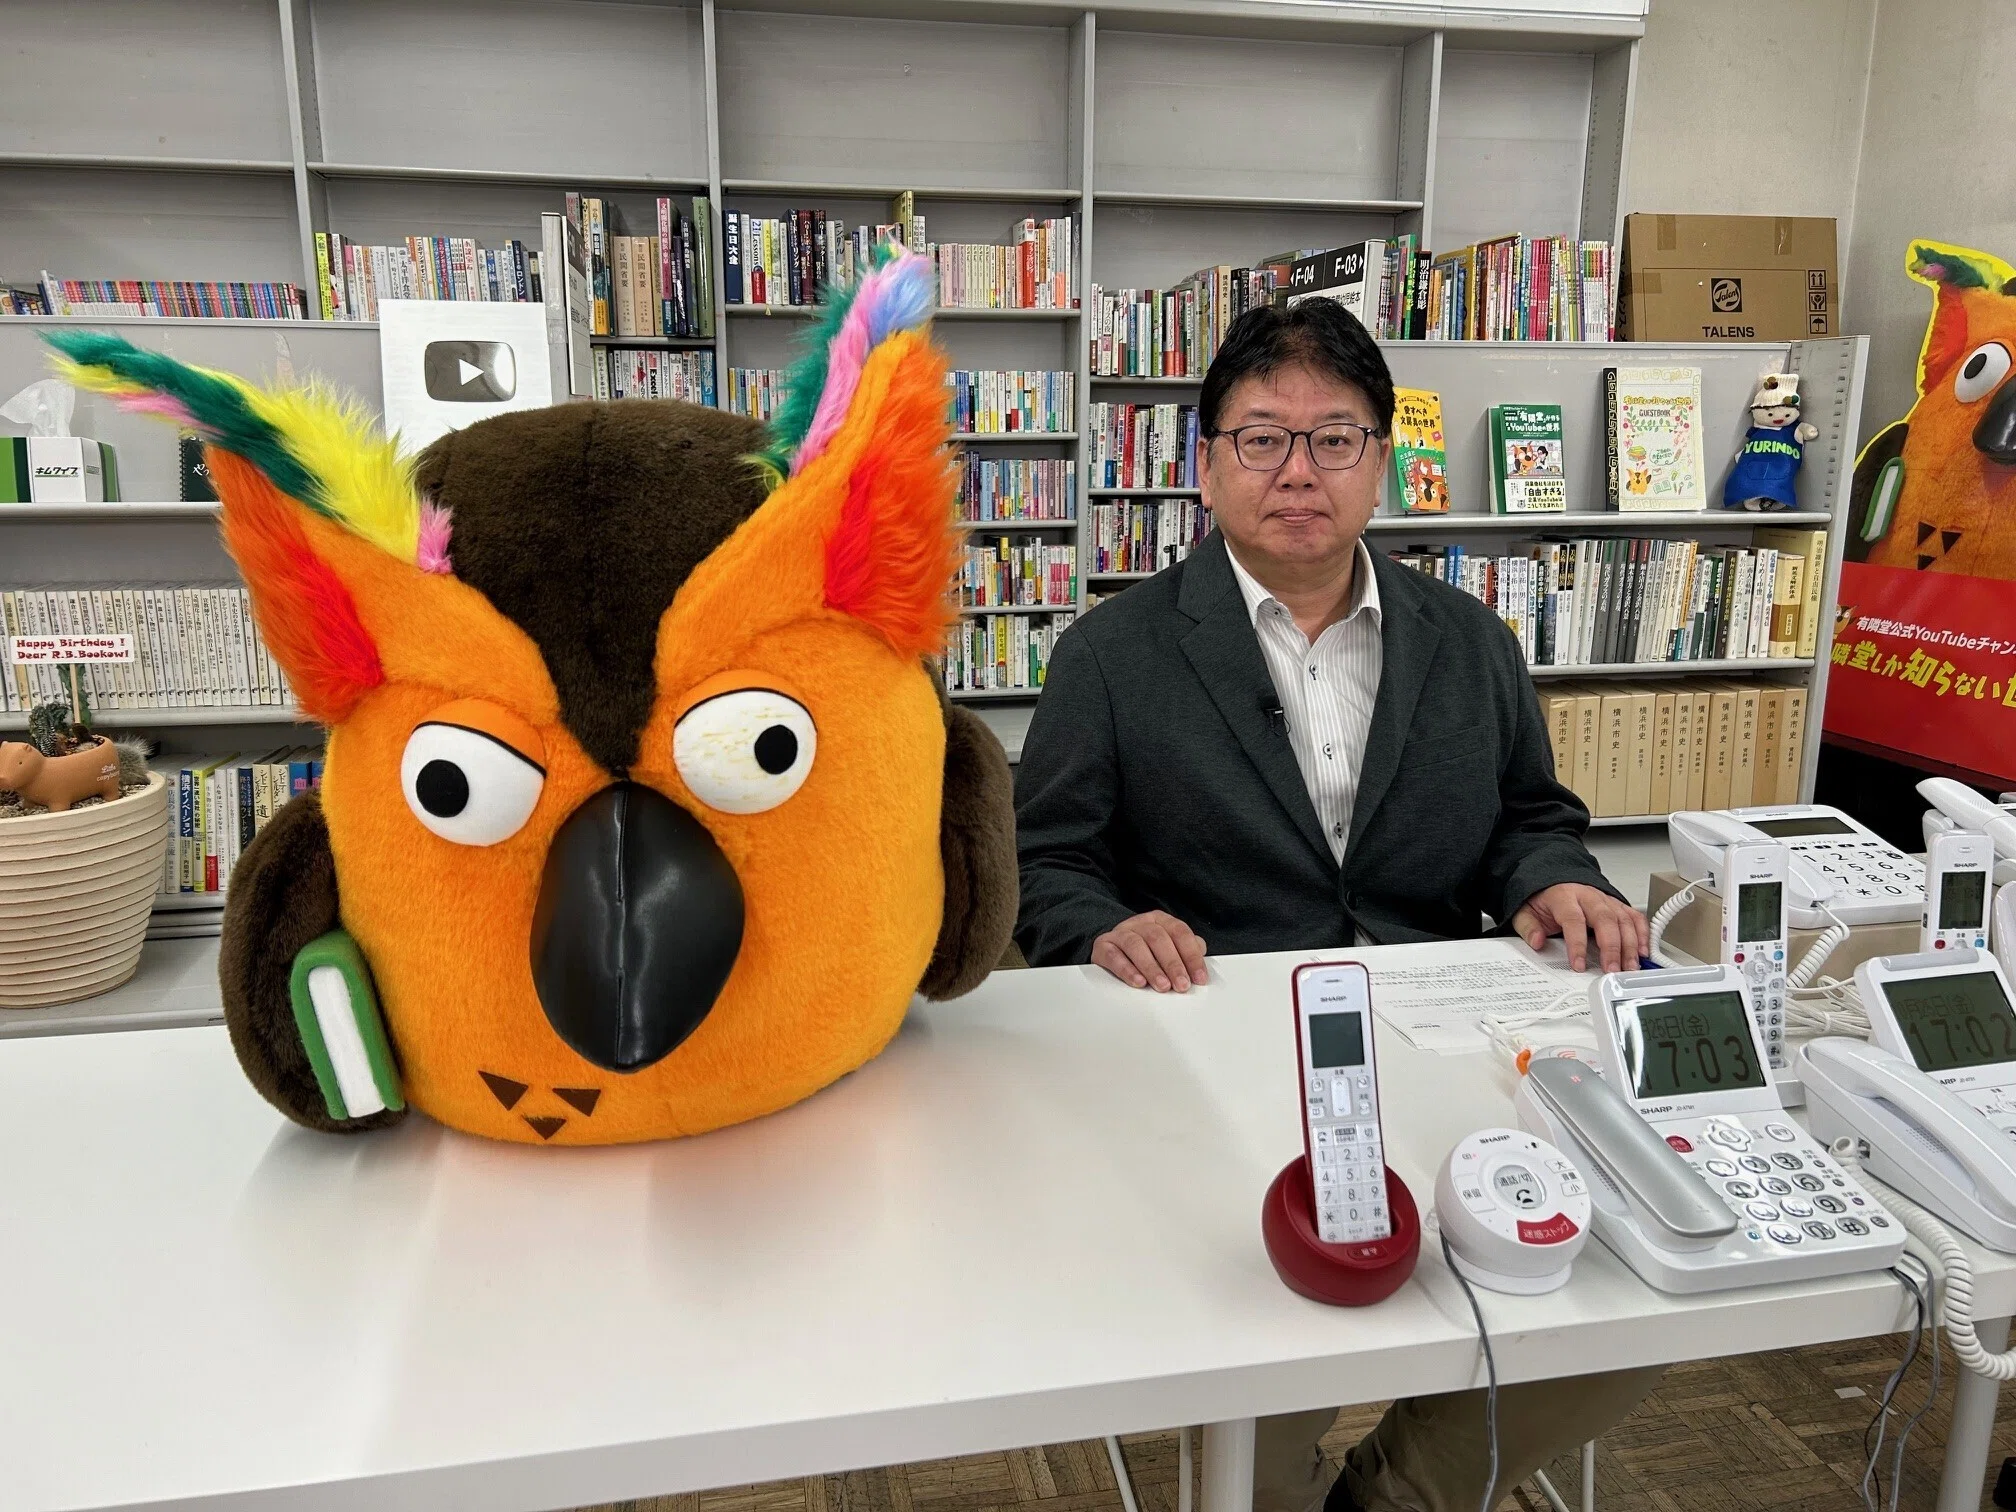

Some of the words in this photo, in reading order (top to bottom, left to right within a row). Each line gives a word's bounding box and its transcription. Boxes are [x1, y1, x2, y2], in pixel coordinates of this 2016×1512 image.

[728, 213, 739, 265] 誕生日大全
[1334, 253, 1358, 278] F-03
[1295, 264, 1315, 287] F-04
[1702, 326, 1755, 338] TALENS
[1403, 405, 1428, 417] 愛すべき
[1126, 405, 1136, 435] CHAVS
[1745, 440, 1801, 460] YURINDO
[35, 466, 79, 475] キムワイプ
[17, 639, 55, 649] Happy
[59, 638, 115, 649] Birthday
[120, 638, 126, 647] !
[1856, 616, 2016, 656] 有隣堂公式YouTubeチャン
[17, 650, 47, 659] Dear
[1558, 710, 1568, 745] 横浜市史
[1583, 709, 1592, 744] 横浜市史
[1638, 706, 1647, 740] 横浜市史
[1659, 706, 1669, 748] 横浜市史
[1678, 705, 1688, 746] 横浜市史
[1696, 705, 1705, 746] 横浜市史
[1720, 702, 1729, 744] 横浜市史
[1743, 699, 1753, 740] 横浜市史
[1766, 700, 1776, 741] 横浜市史
[1789, 699, 1799, 740] 横浜市史
[1612, 708, 1621, 750] 横浜市史
[1803, 854, 1817, 863] 1
[1830, 852, 1849, 861] 2
[1858, 851, 1875, 860] 3
[1822, 865, 1836, 873] 4
[1849, 863, 1864, 872] 5
[1878, 861, 1894, 870] 6
[1835, 876, 1849, 885] 7
[1866, 874, 1884, 883] 8
[1894, 872, 1911, 881] 9
[1884, 885, 1902, 895] 0
[1772, 1000, 1778, 1010] 3
[1771, 1015, 1778, 1025] 6
[1909, 1012, 2016, 1066] 17:02
[1940, 1077, 1957, 1086] ARP
[1640, 1105, 1673, 1115] SHARP
[1479, 1134, 1511, 1144] SHARP
[1321, 1151, 1326, 1163] 1
[1343, 1148, 1351, 1160] 2
[1367, 1146, 1375, 1158] 3
[1555, 1160, 1566, 1170] 大
[1321, 1171, 1330, 1183] 4
[1346, 1168, 1354, 1180] 5
[1369, 1165, 1377, 1177] 6
[1497, 1172, 1533, 1187] 通話/切
[1324, 1190, 1331, 1203] 7
[1348, 1188, 1356, 1201] 8
[1371, 1185, 1379, 1198] 9
[1462, 1188, 1482, 1200] 保留
[1570, 1183, 1581, 1193] 小
[1349, 1208, 1358, 1220] 0
[1373, 1206, 1382, 1218] #
